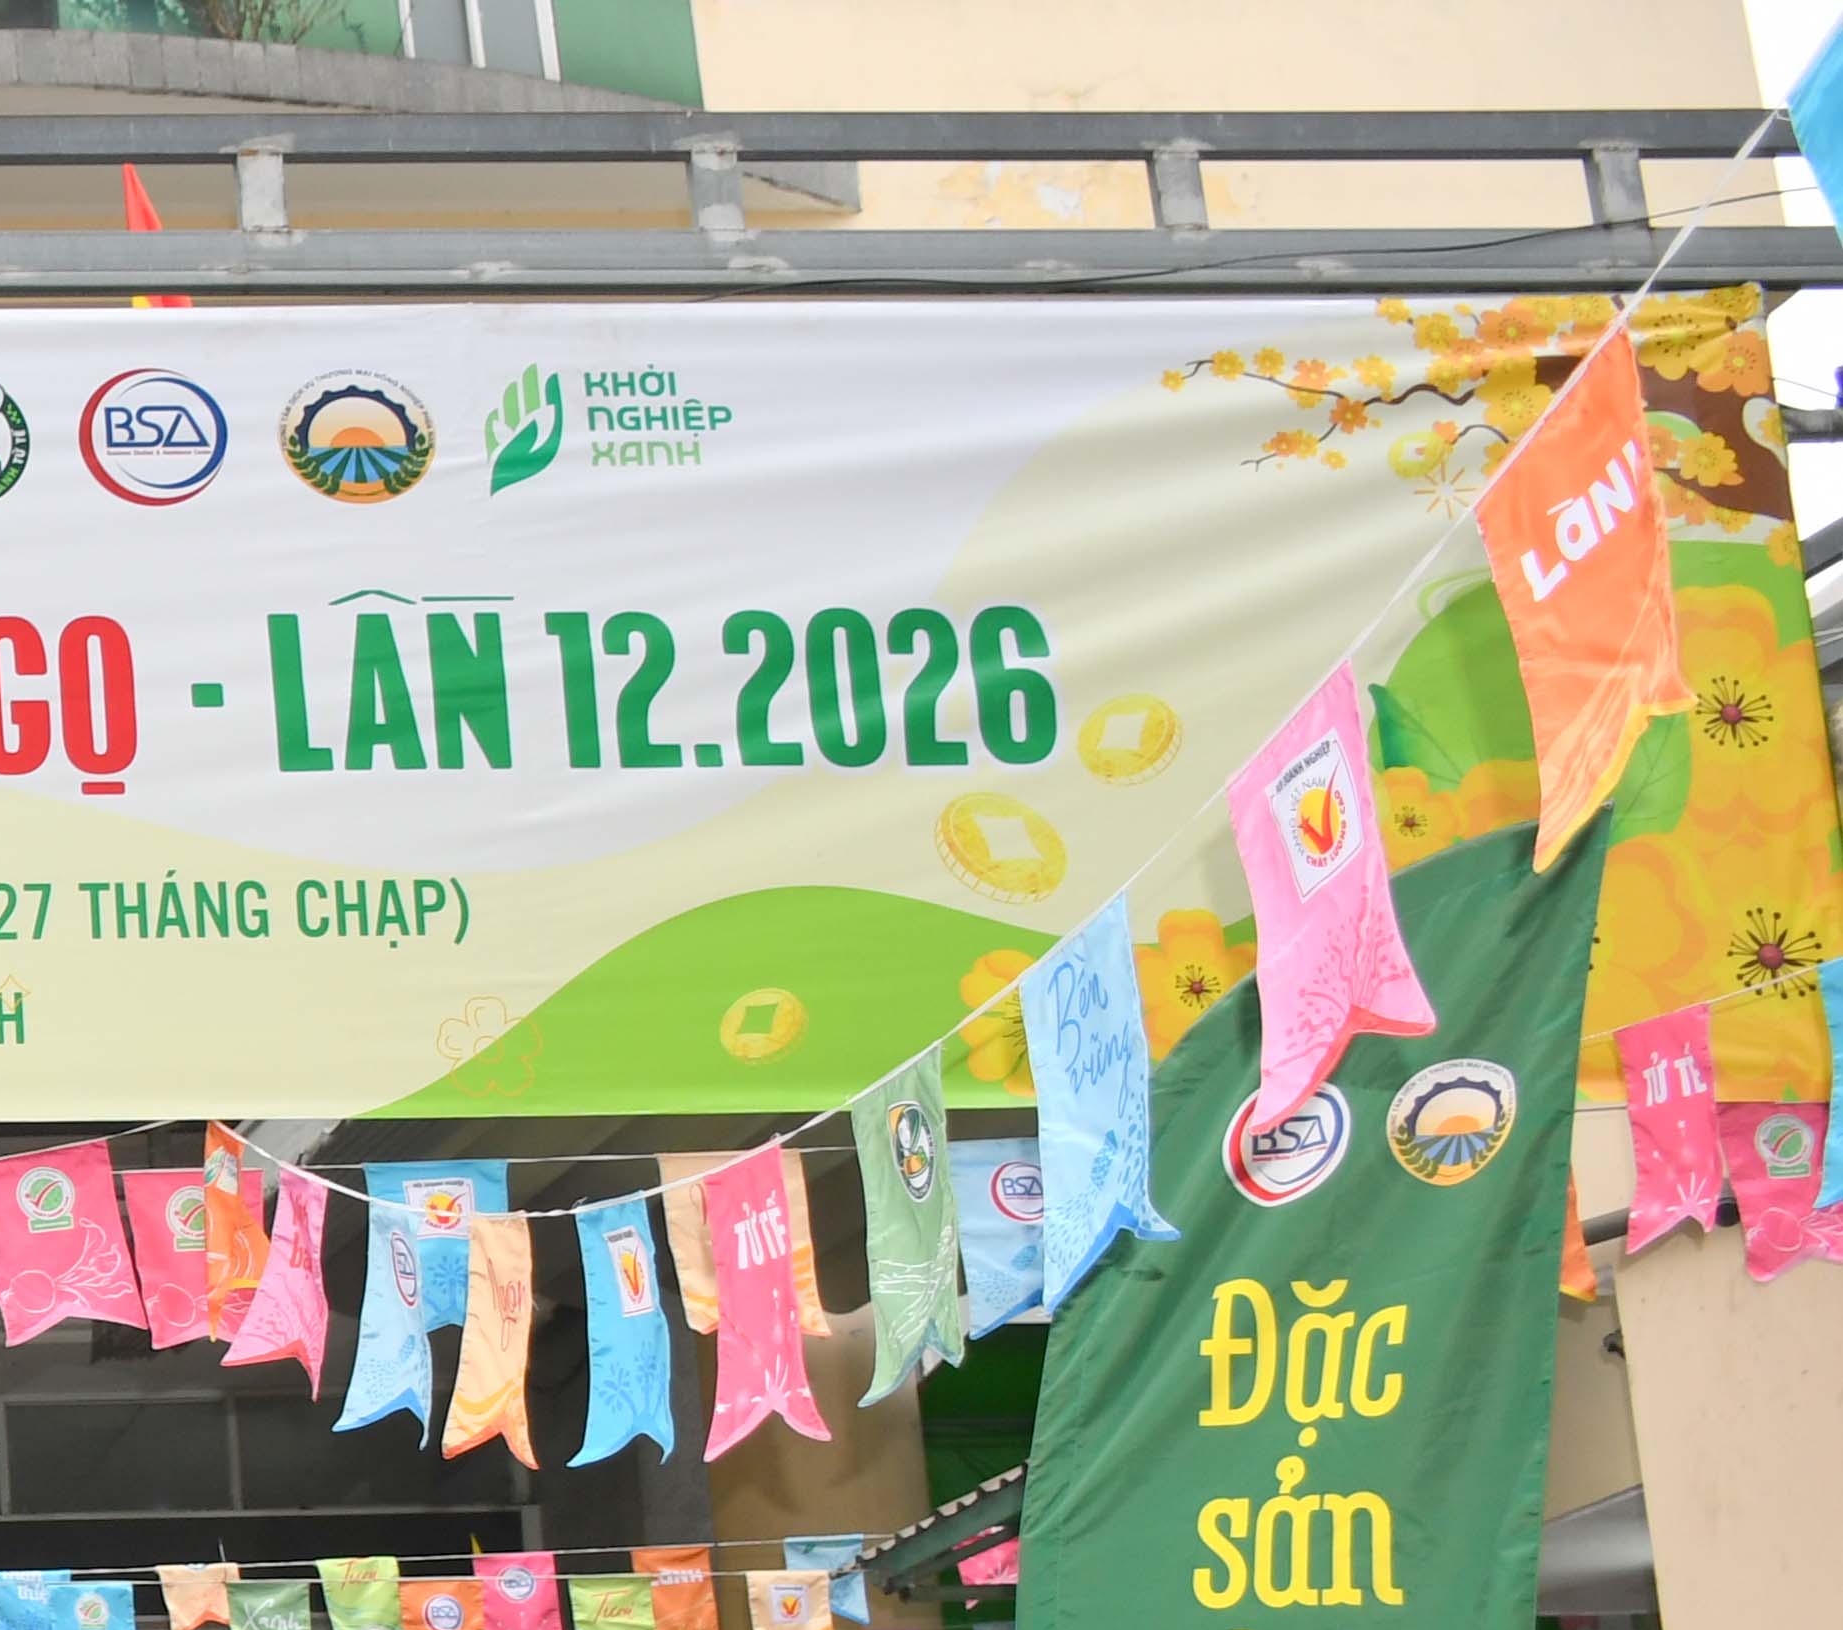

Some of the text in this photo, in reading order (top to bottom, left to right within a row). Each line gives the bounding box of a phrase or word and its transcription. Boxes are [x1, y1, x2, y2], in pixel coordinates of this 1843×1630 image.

[584, 364, 676, 397] KHỞI
[105, 405, 210, 448] BSA
[589, 399, 732, 438] NGHIỆP
[592, 441, 701, 466] XANH
[545, 604, 1058, 771] 12.2026
[86, 870, 271, 941] THÁNG
[294, 876, 471, 948] CHẠP)
[1642, 1049, 1672, 1109] TỬ
[1198, 1277, 1407, 1448] Đặc
[1194, 1454, 1404, 1609] sản
